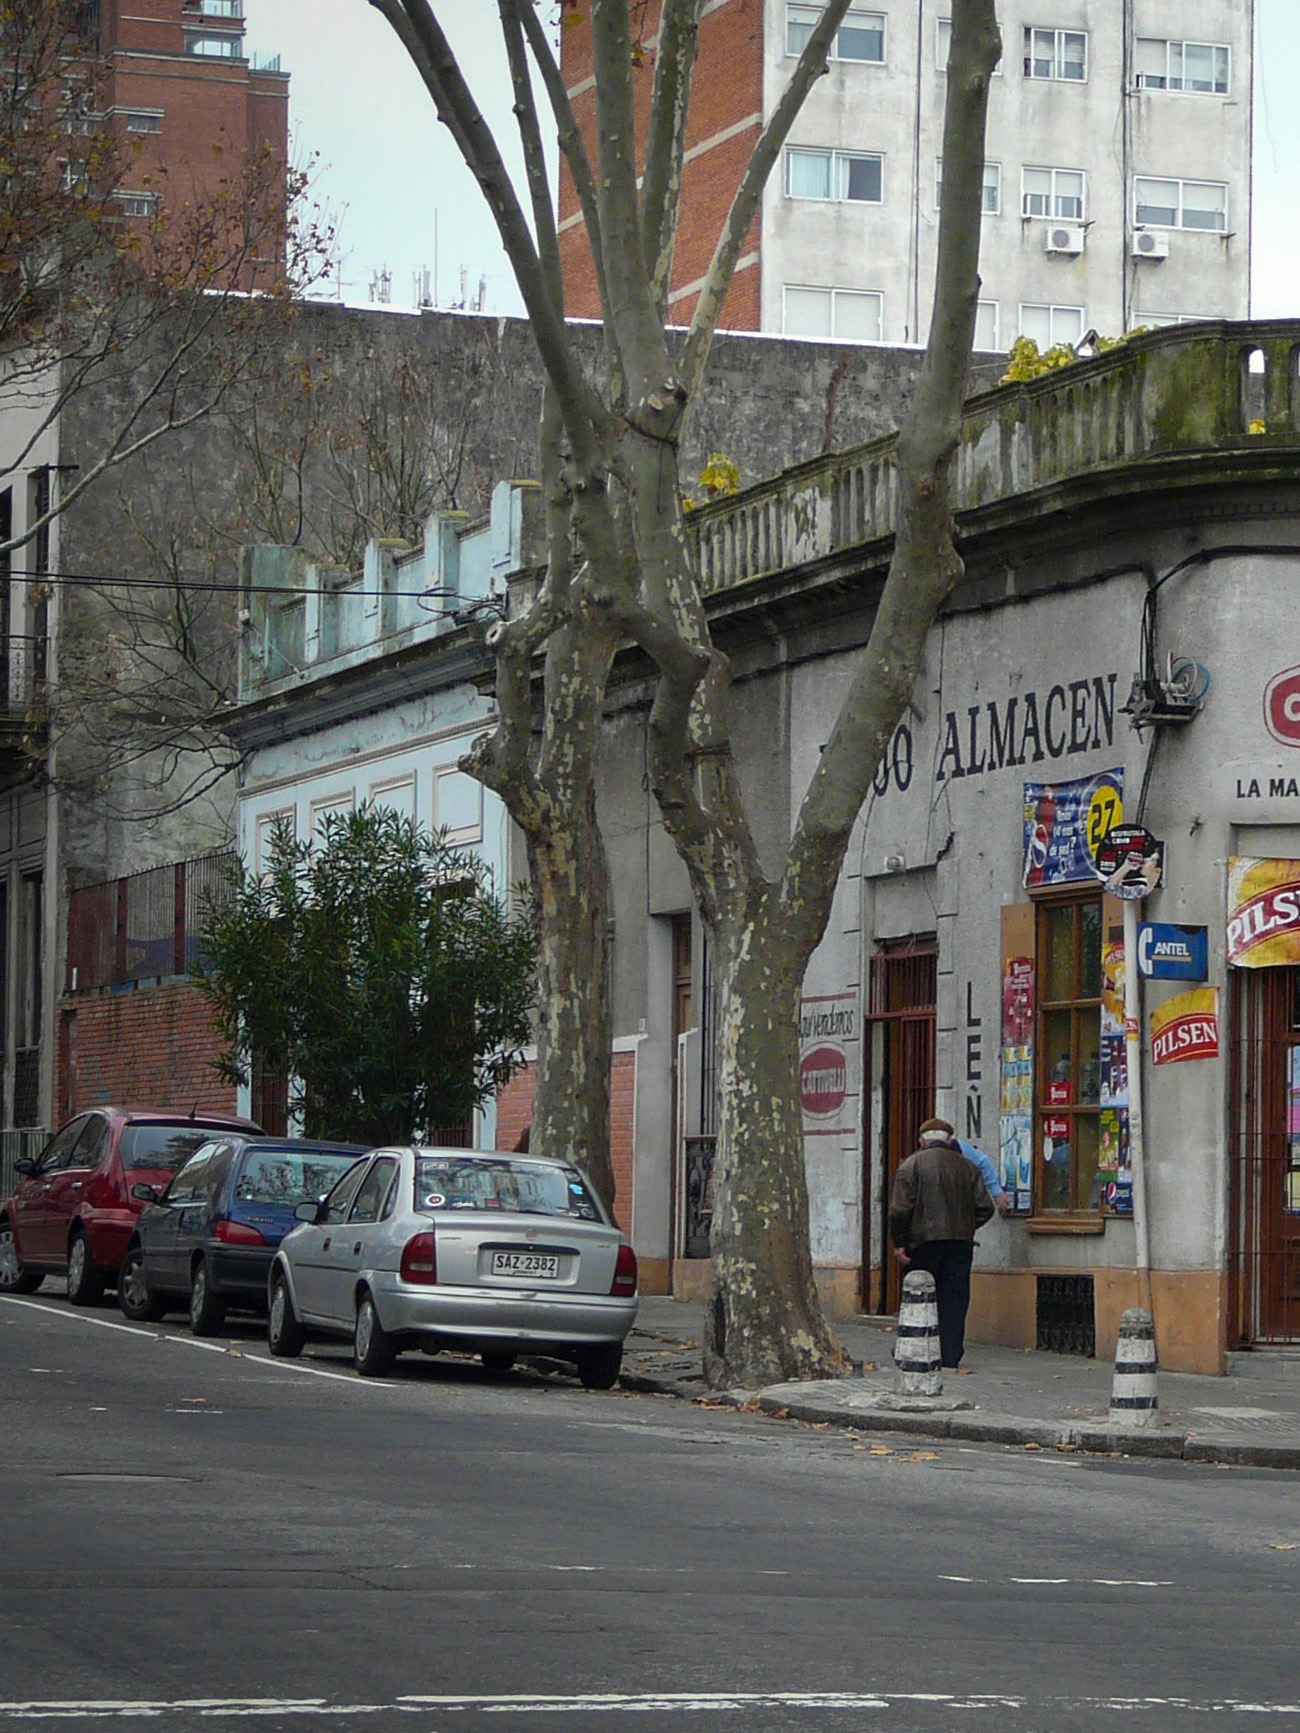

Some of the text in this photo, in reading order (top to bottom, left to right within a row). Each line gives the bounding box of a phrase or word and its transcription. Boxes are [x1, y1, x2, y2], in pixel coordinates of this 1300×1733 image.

[936, 673, 1117, 781] ALMACEN
[1236, 779, 1261, 799] LA
[1091, 798, 1115, 845] 27
[1155, 942, 1189, 955] ANTEL
[1153, 1022, 1217, 1062] PILSEN
[967, 981, 982, 1149] LEÑ
[496, 1255, 556, 1271] SAZ 2382
